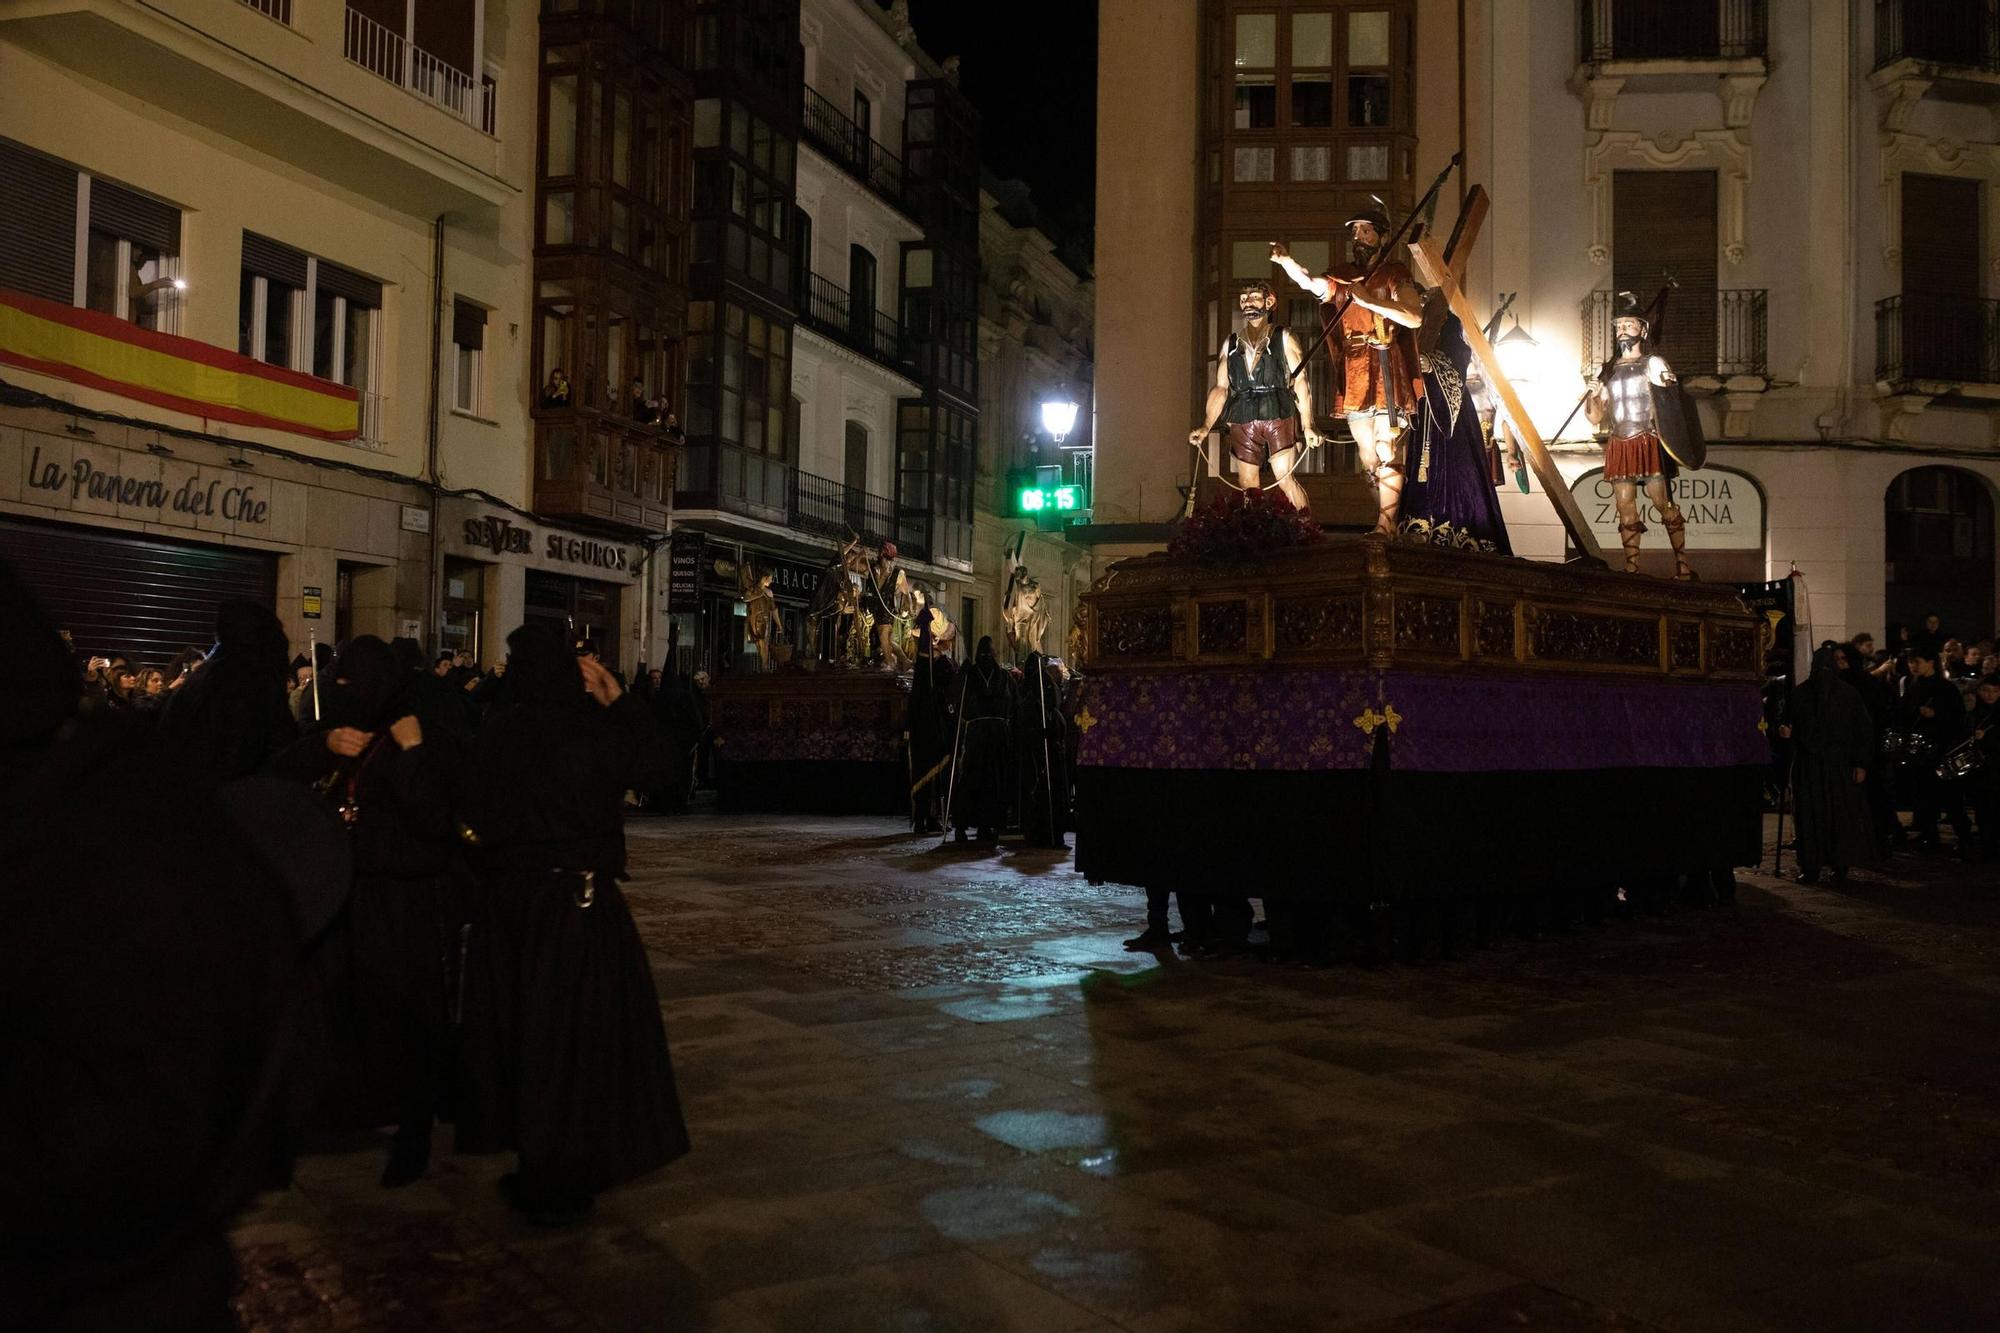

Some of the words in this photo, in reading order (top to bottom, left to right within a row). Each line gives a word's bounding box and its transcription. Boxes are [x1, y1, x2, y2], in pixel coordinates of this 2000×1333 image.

[28, 446, 67, 491] La
[72, 458, 170, 507] Panera
[173, 475, 221, 516] del
[222, 486, 267, 524] Che
[1594, 503, 1734, 524] ZAMOANA
[546, 534, 627, 571] SEGUROS
